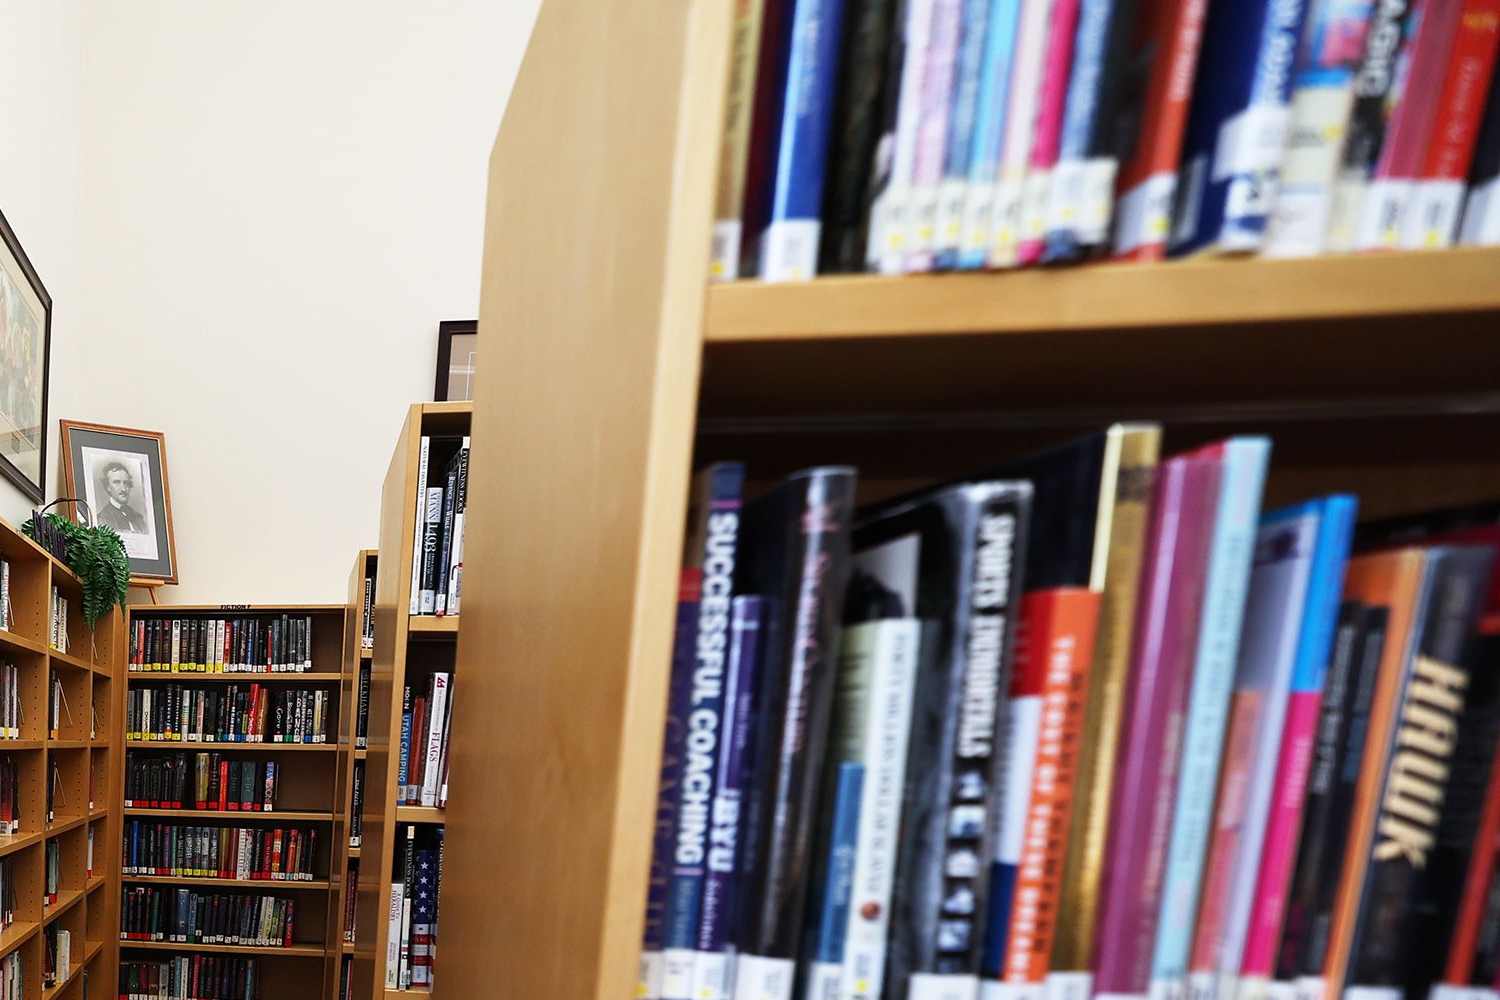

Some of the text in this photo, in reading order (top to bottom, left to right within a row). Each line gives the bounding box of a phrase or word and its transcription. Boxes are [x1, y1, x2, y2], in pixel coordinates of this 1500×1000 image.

[418, 445, 429, 499] NATURAL DISASTERS
[457, 449, 469, 513] EYEWITNESS BOOKS
[426, 490, 438, 523] MANN
[443, 475, 457, 531] REVENGE WHALE
[423, 523, 439, 552] 1493
[359, 672, 370, 716] BECKHAM
[677, 513, 740, 866] SUCCESSFUL COACHING
[398, 714, 411, 783] UTAH CAMPING
[429, 731, 442, 763] FLAGS
[1371, 656, 1470, 871] HAWK
[404, 840, 414, 898] EYEWITNESS BOOKS
[389, 889, 398, 921] HERALDRY
